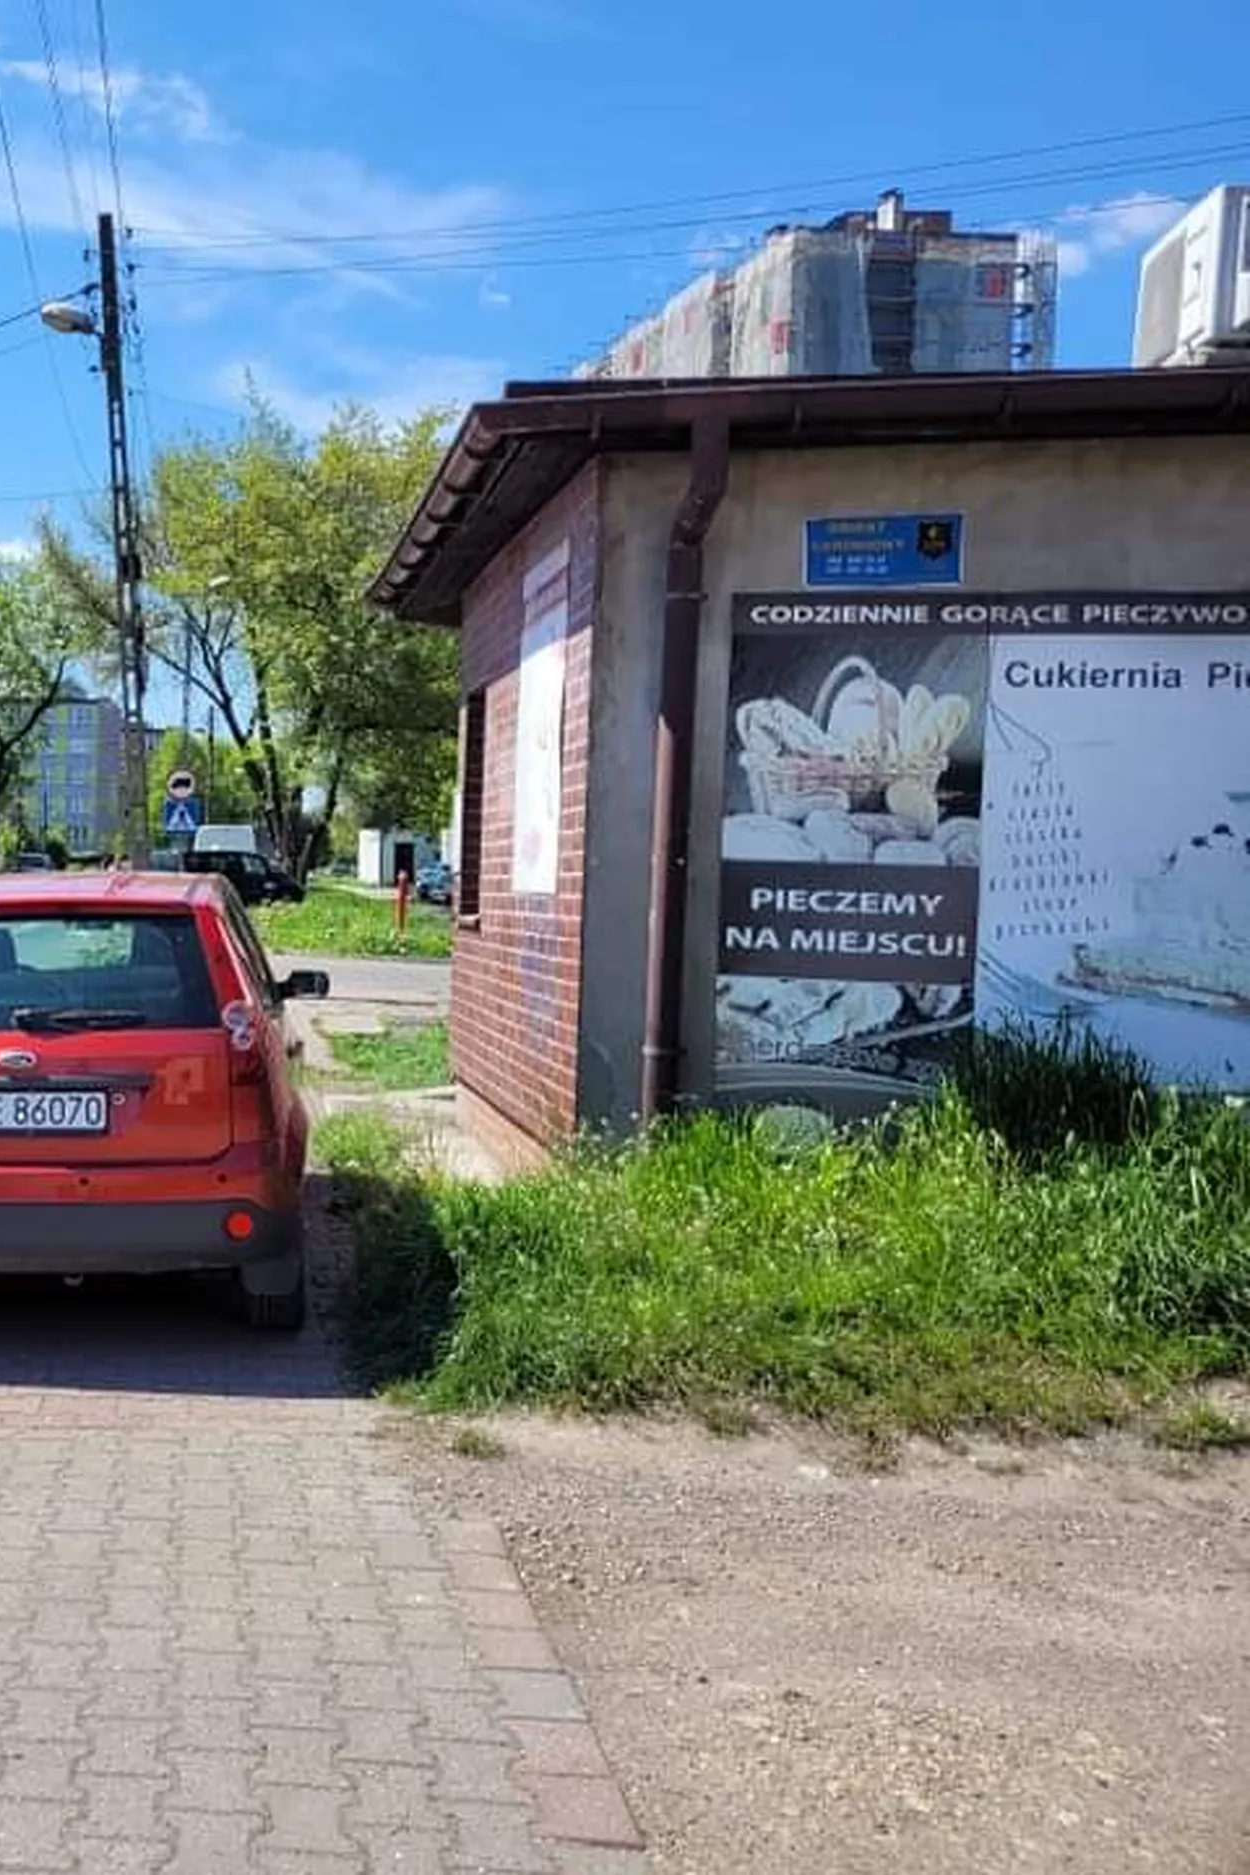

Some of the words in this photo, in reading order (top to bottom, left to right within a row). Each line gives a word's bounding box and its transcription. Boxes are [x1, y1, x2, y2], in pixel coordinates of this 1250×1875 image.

[750, 604, 929, 625] CODZIENNIE
[940, 604, 1069, 627] GORĄCE
[1082, 604, 1246, 625] PIECZYWO
[1004, 660, 1182, 688] Cukiernia
[1208, 660, 1250, 688] Pi
[750, 887, 943, 917] PIECZEMY
[725, 925, 780, 950] NA
[790, 927, 967, 958] MIEJSCU!
[13, 1096, 102, 1126] 86070
